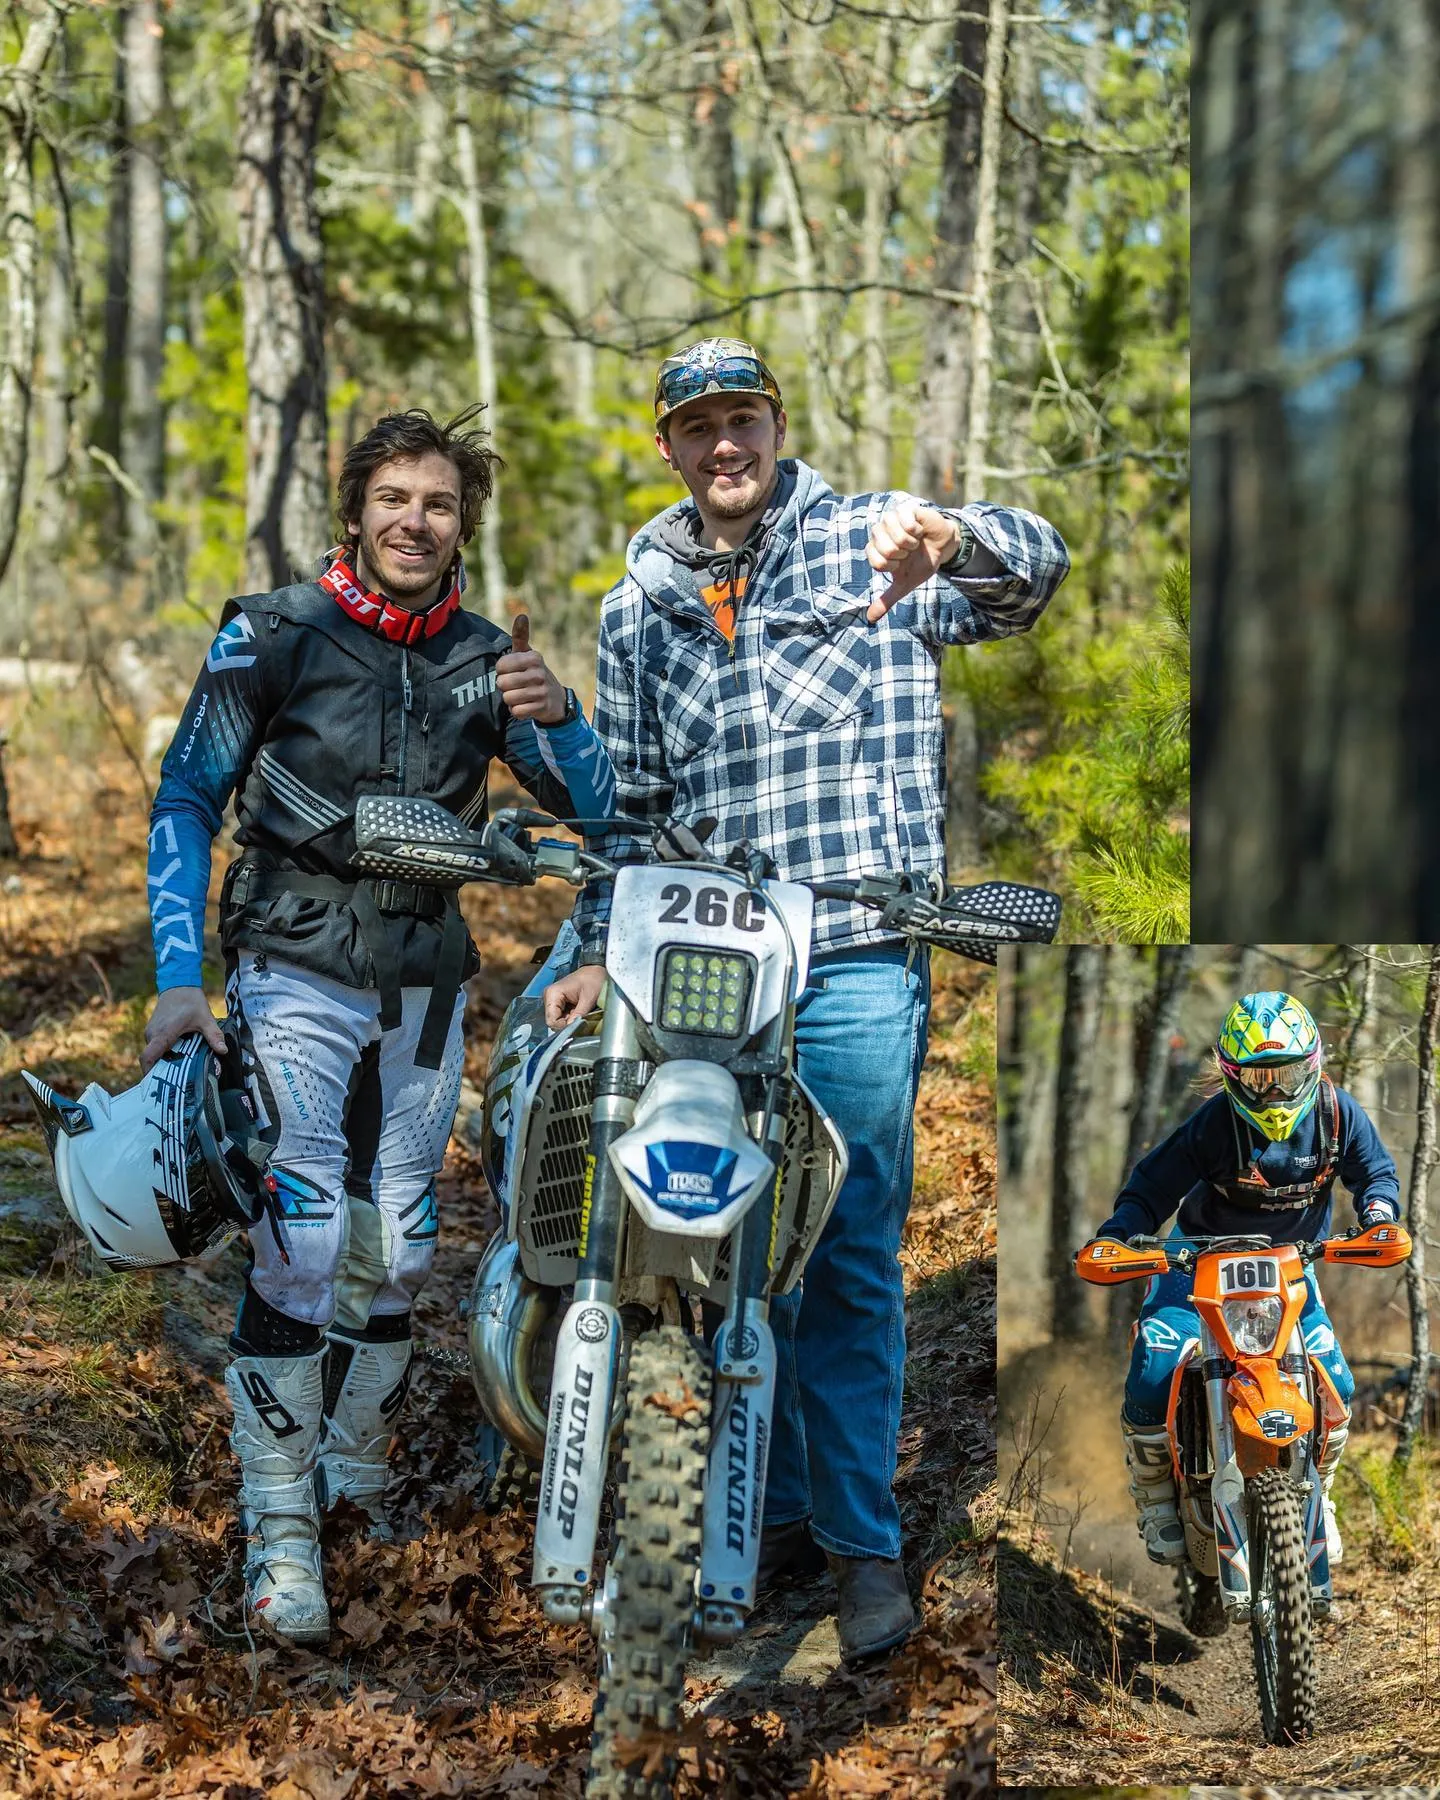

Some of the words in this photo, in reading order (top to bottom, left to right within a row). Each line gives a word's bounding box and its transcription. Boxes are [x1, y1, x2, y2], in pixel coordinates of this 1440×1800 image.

[325, 570, 397, 625] SCOTT
[181, 693, 208, 766] PRO-FIT
[392, 844, 490, 870] ACERBIS
[658, 883, 766, 932] 26C
[923, 917, 1021, 938] ACERBIS
[279, 1060, 310, 1120] HELIUM
[1221, 1261, 1277, 1290] 16D
[553, 1391, 567, 1435] TOWN
[556, 1364, 594, 1540] DUNLOP
[543, 1448, 557, 1518] COUNTRY
